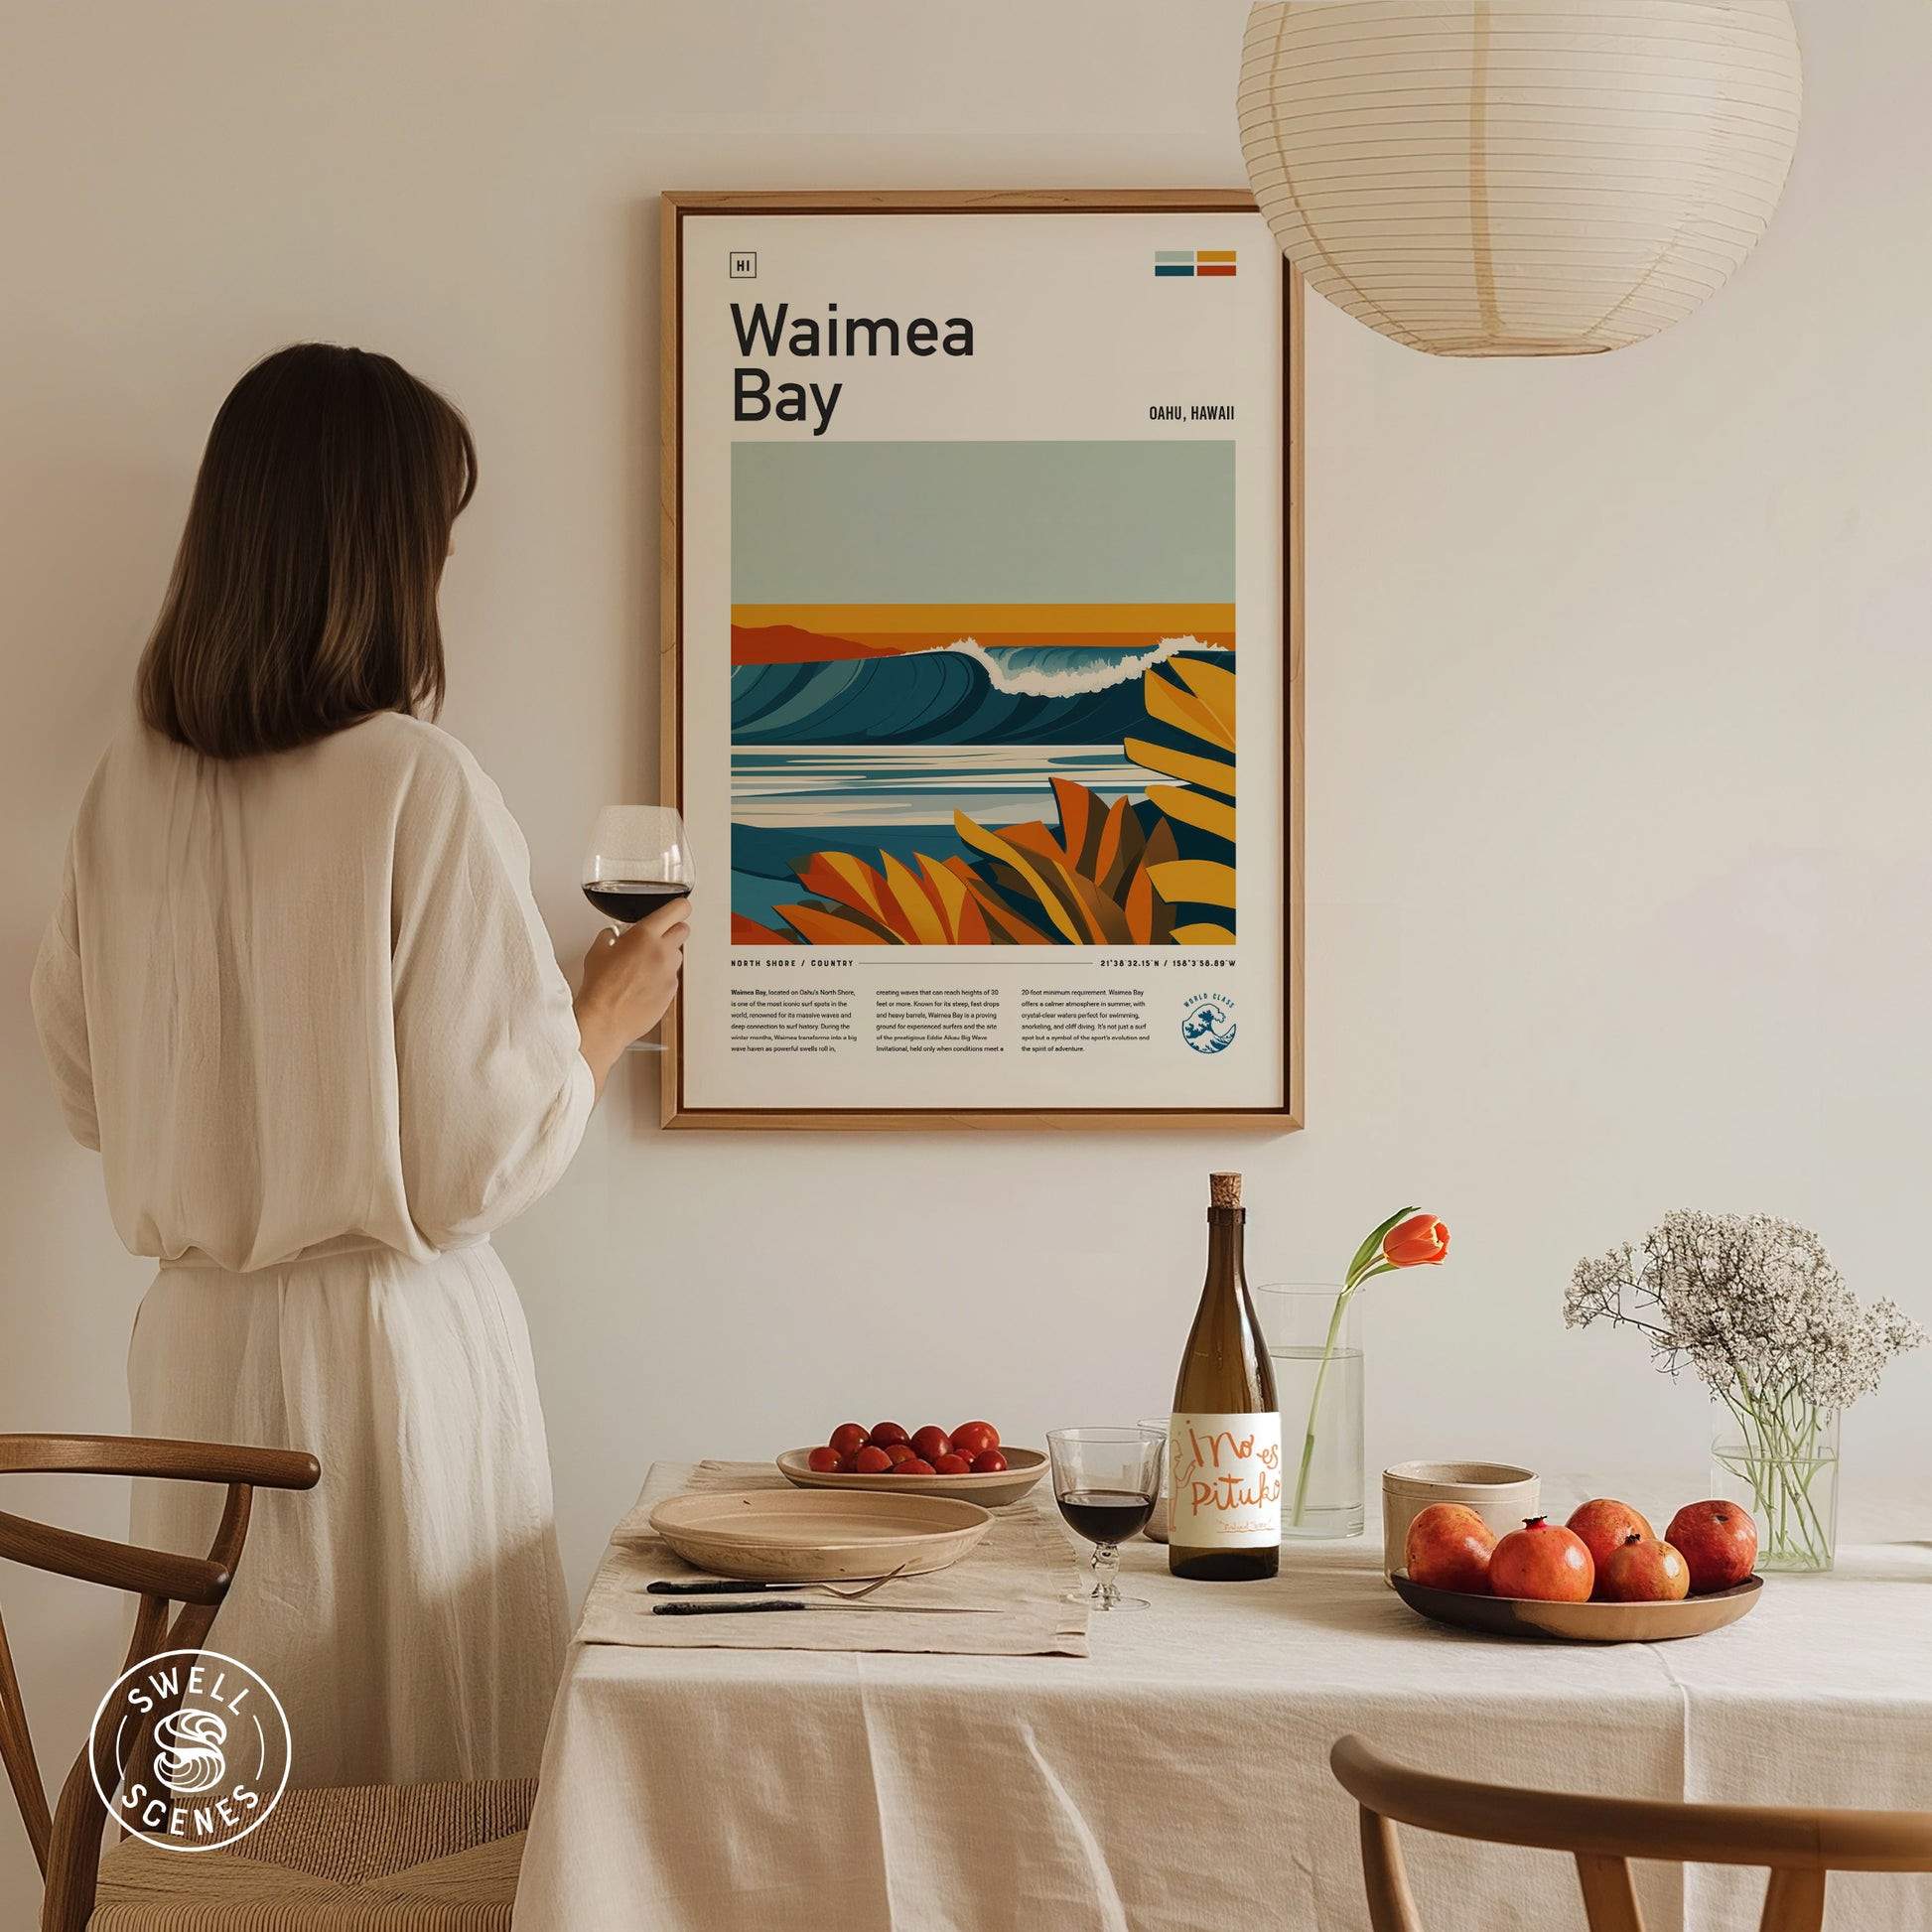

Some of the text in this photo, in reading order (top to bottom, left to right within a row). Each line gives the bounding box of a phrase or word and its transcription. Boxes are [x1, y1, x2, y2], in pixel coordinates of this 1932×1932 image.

[737, 260, 750, 272] HI
[731, 303, 974, 356] Waimea
[734, 367, 842, 436] Bay
[1150, 406, 1235, 422] OAHU, HAWAII
[1183, 993, 1235, 1008] WORLD CLASS
[1257, 1444, 1279, 1469] es
